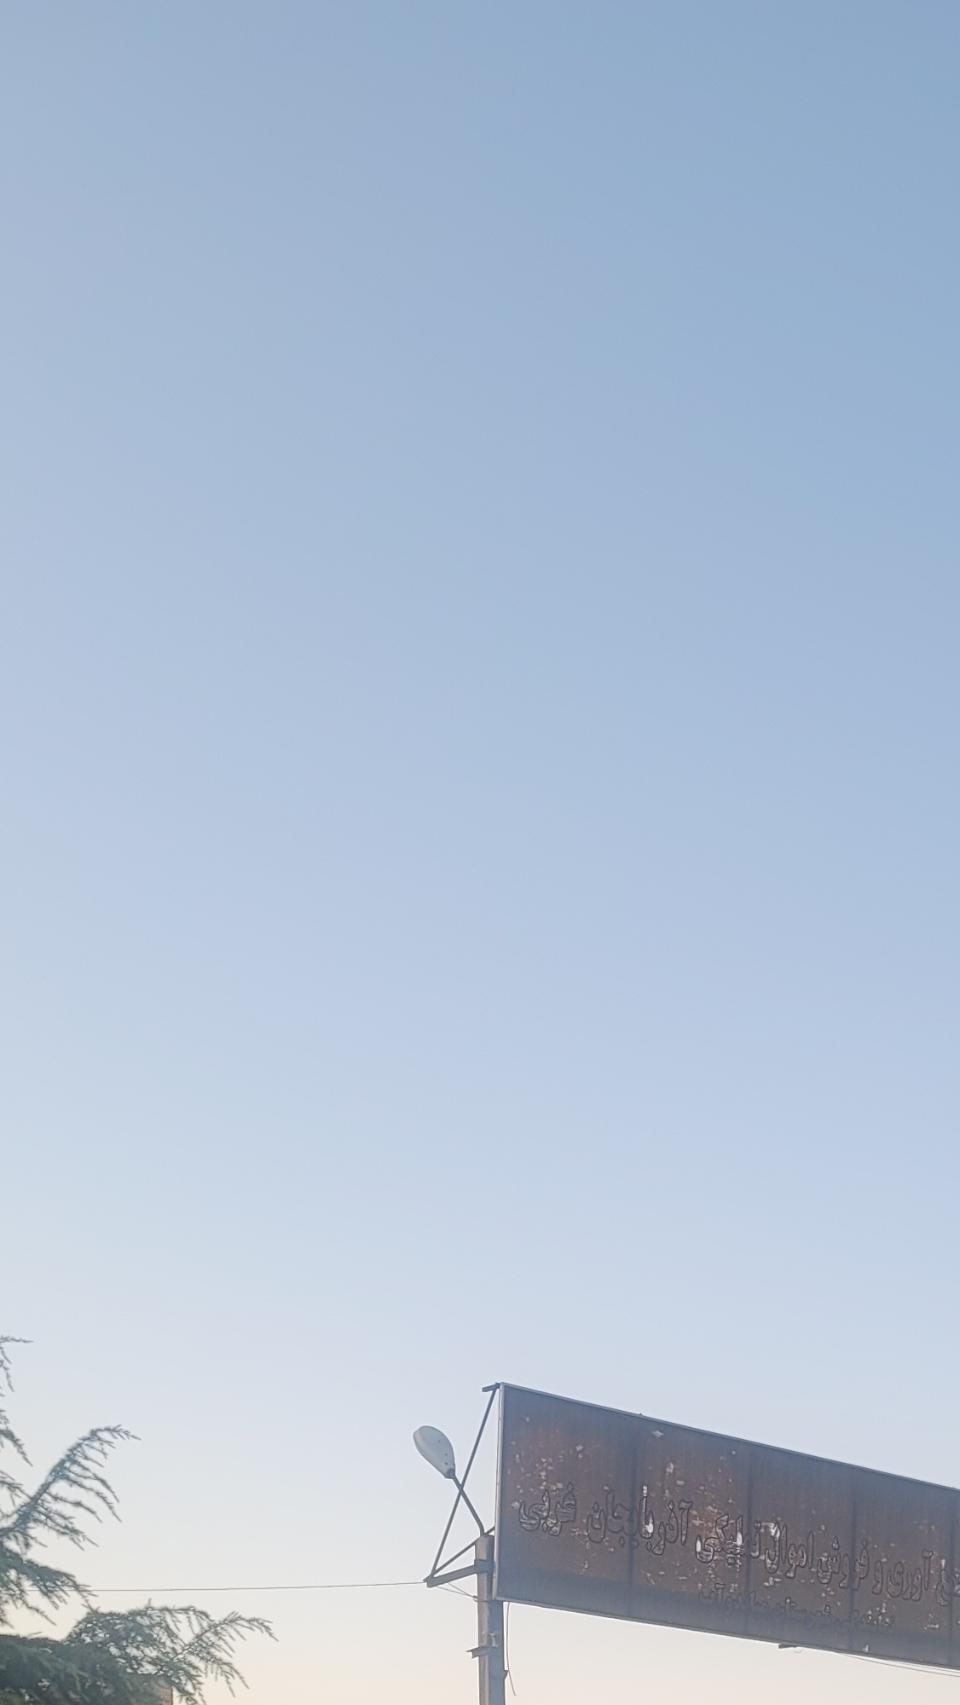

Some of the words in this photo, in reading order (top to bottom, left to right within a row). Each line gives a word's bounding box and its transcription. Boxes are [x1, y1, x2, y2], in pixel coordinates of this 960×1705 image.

[518, 1480, 577, 1537] غربی
[586, 1486, 694, 1557] آذربایجان
[765, 1521, 816, 1580] اموال
[816, 1536, 870, 1591] فروش
[871, 1559, 884, 1596] و
[887, 1547, 934, 1602] آوری
